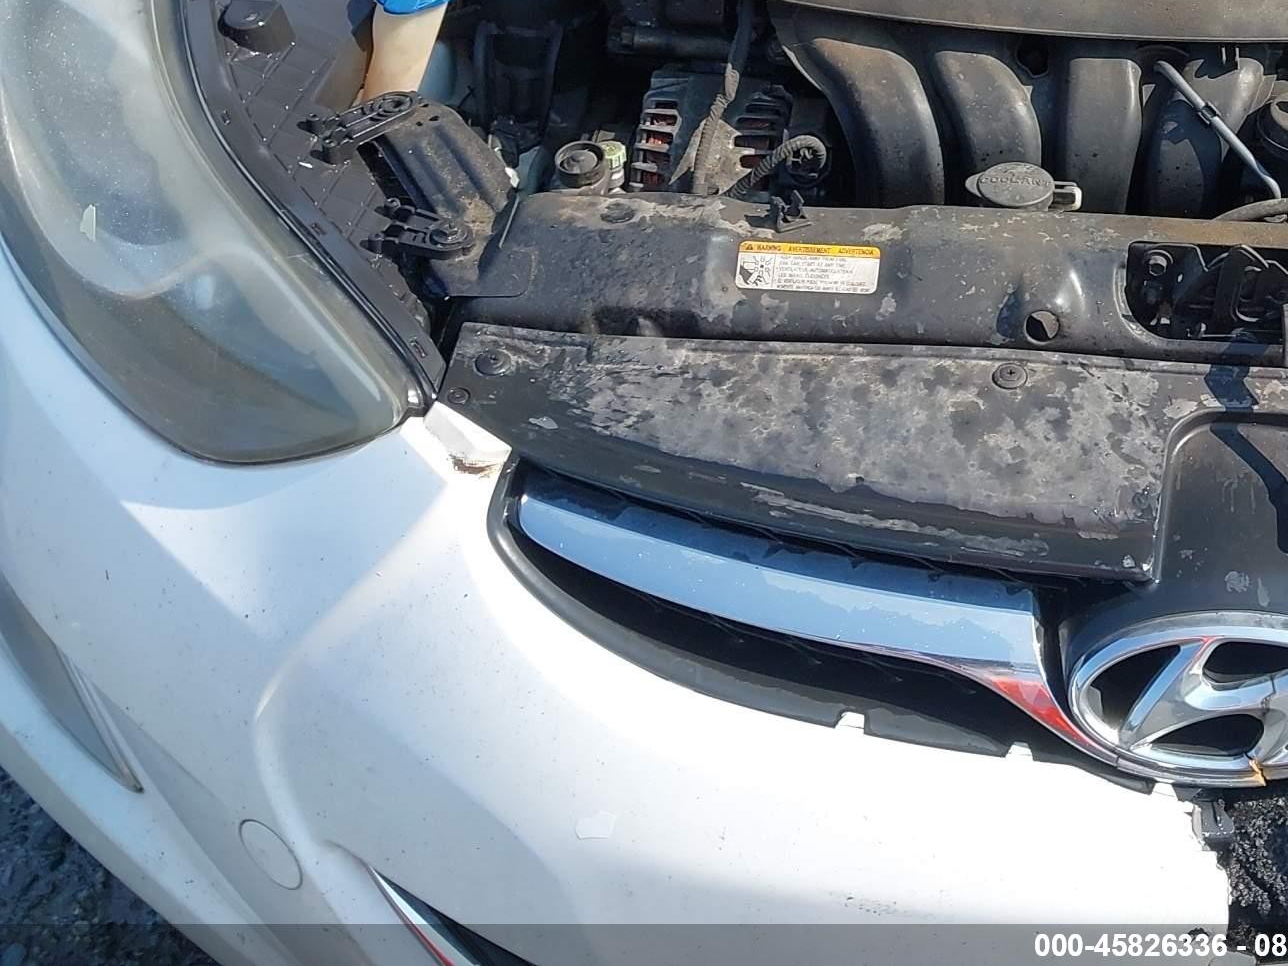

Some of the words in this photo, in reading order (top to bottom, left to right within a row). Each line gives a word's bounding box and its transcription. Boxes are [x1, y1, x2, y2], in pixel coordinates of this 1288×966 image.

[980, 175, 1052, 187] COOLANT
[756, 244, 782, 252] WARNING
[787, 245, 832, 254] AVERTISSEMENT
[838, 247, 874, 256] ADVERTENCIA
